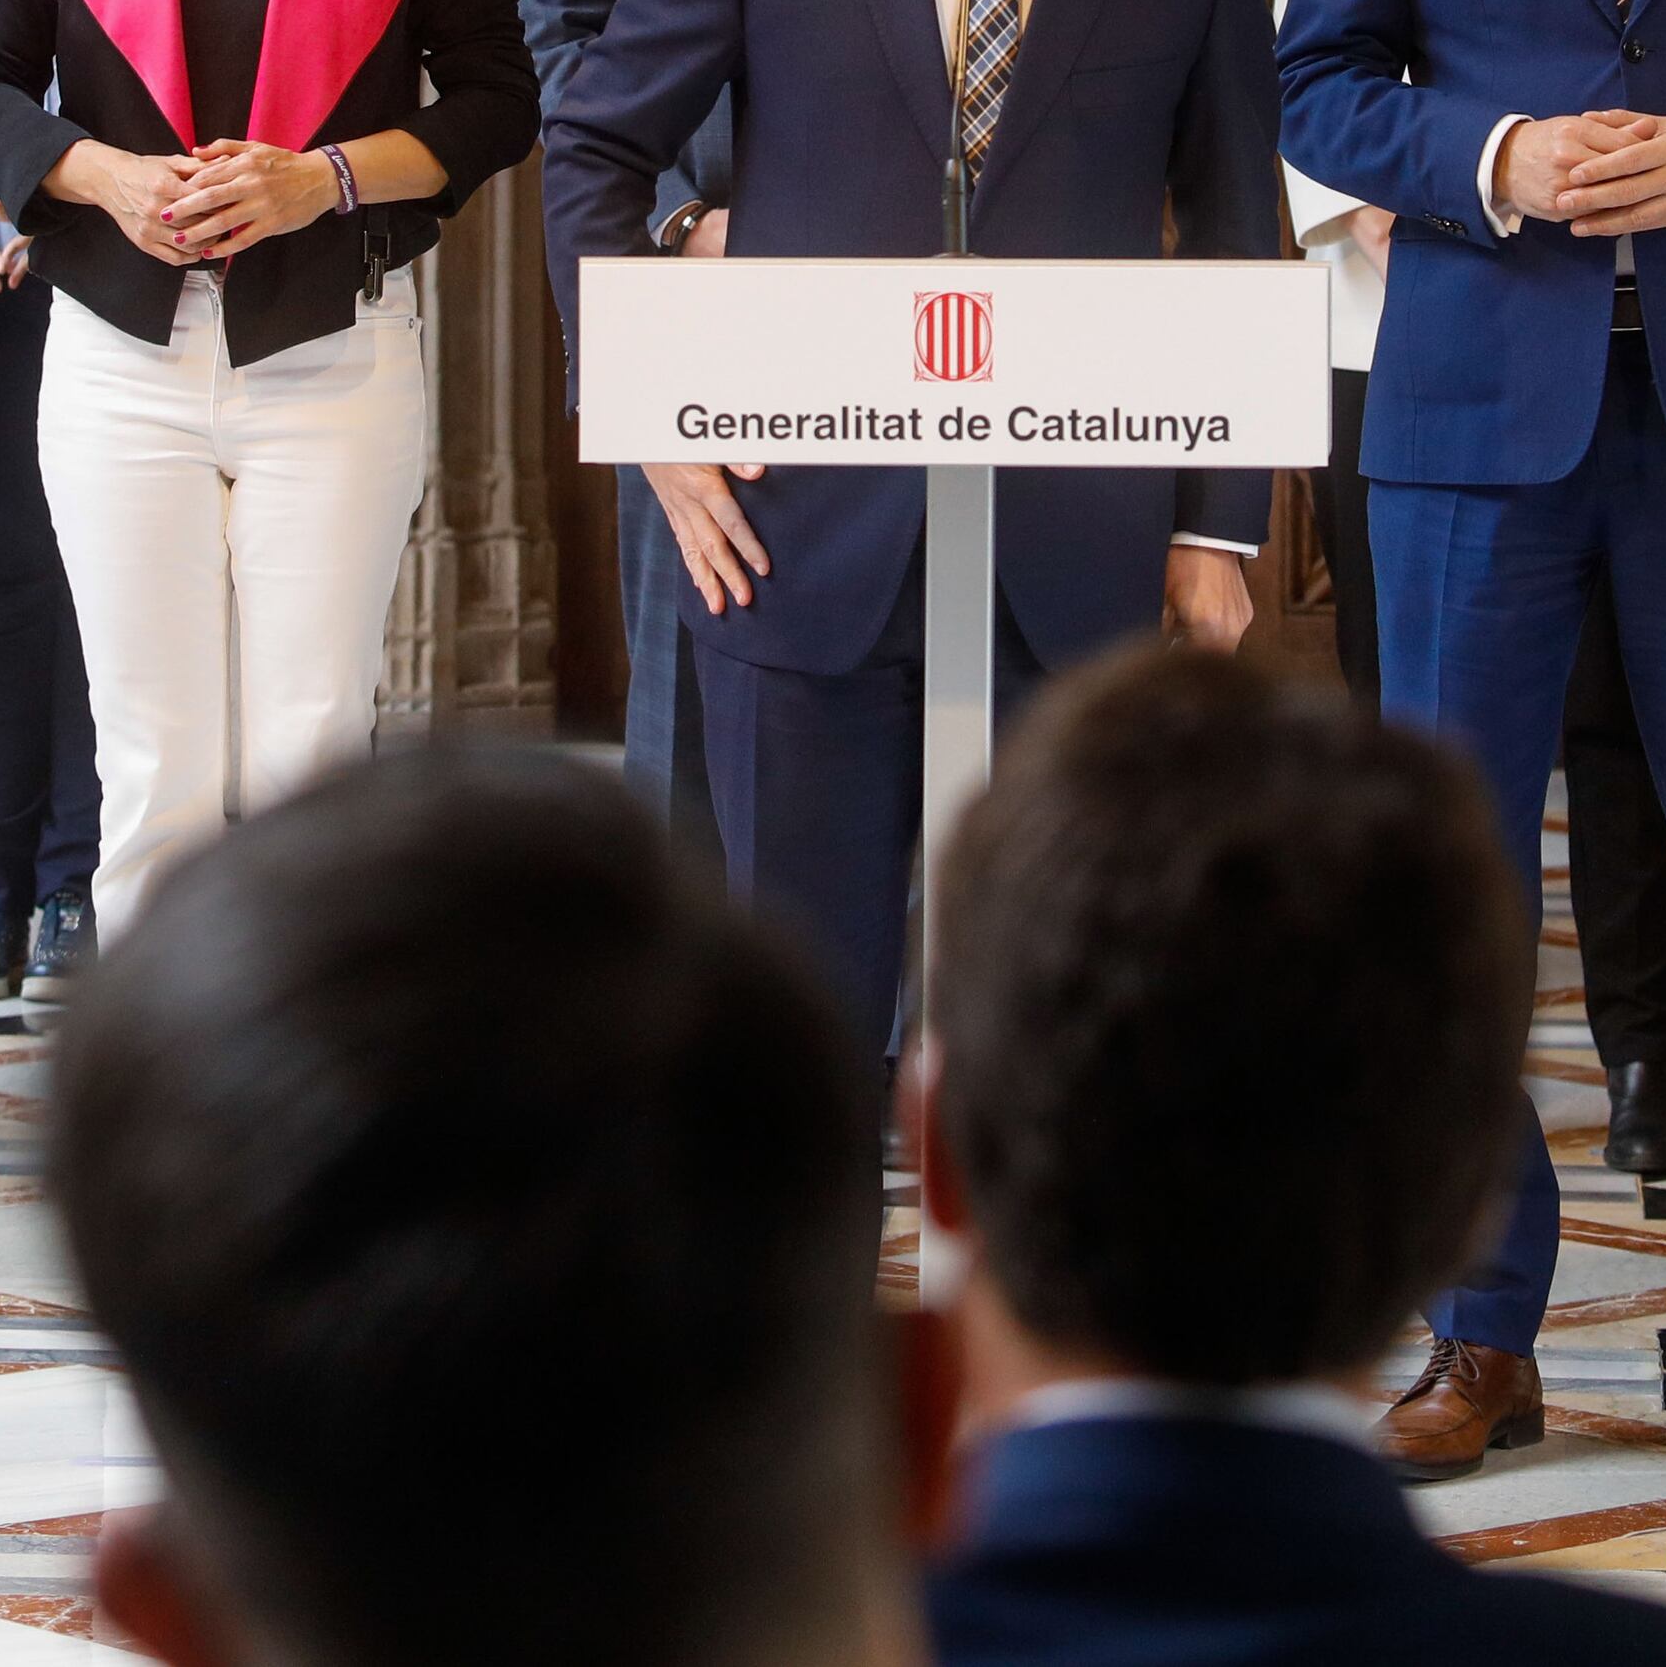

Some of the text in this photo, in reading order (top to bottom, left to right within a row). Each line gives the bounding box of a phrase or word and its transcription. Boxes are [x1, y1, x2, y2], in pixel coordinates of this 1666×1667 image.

[676, 404, 1230, 452] Generalitat de Catalunya
